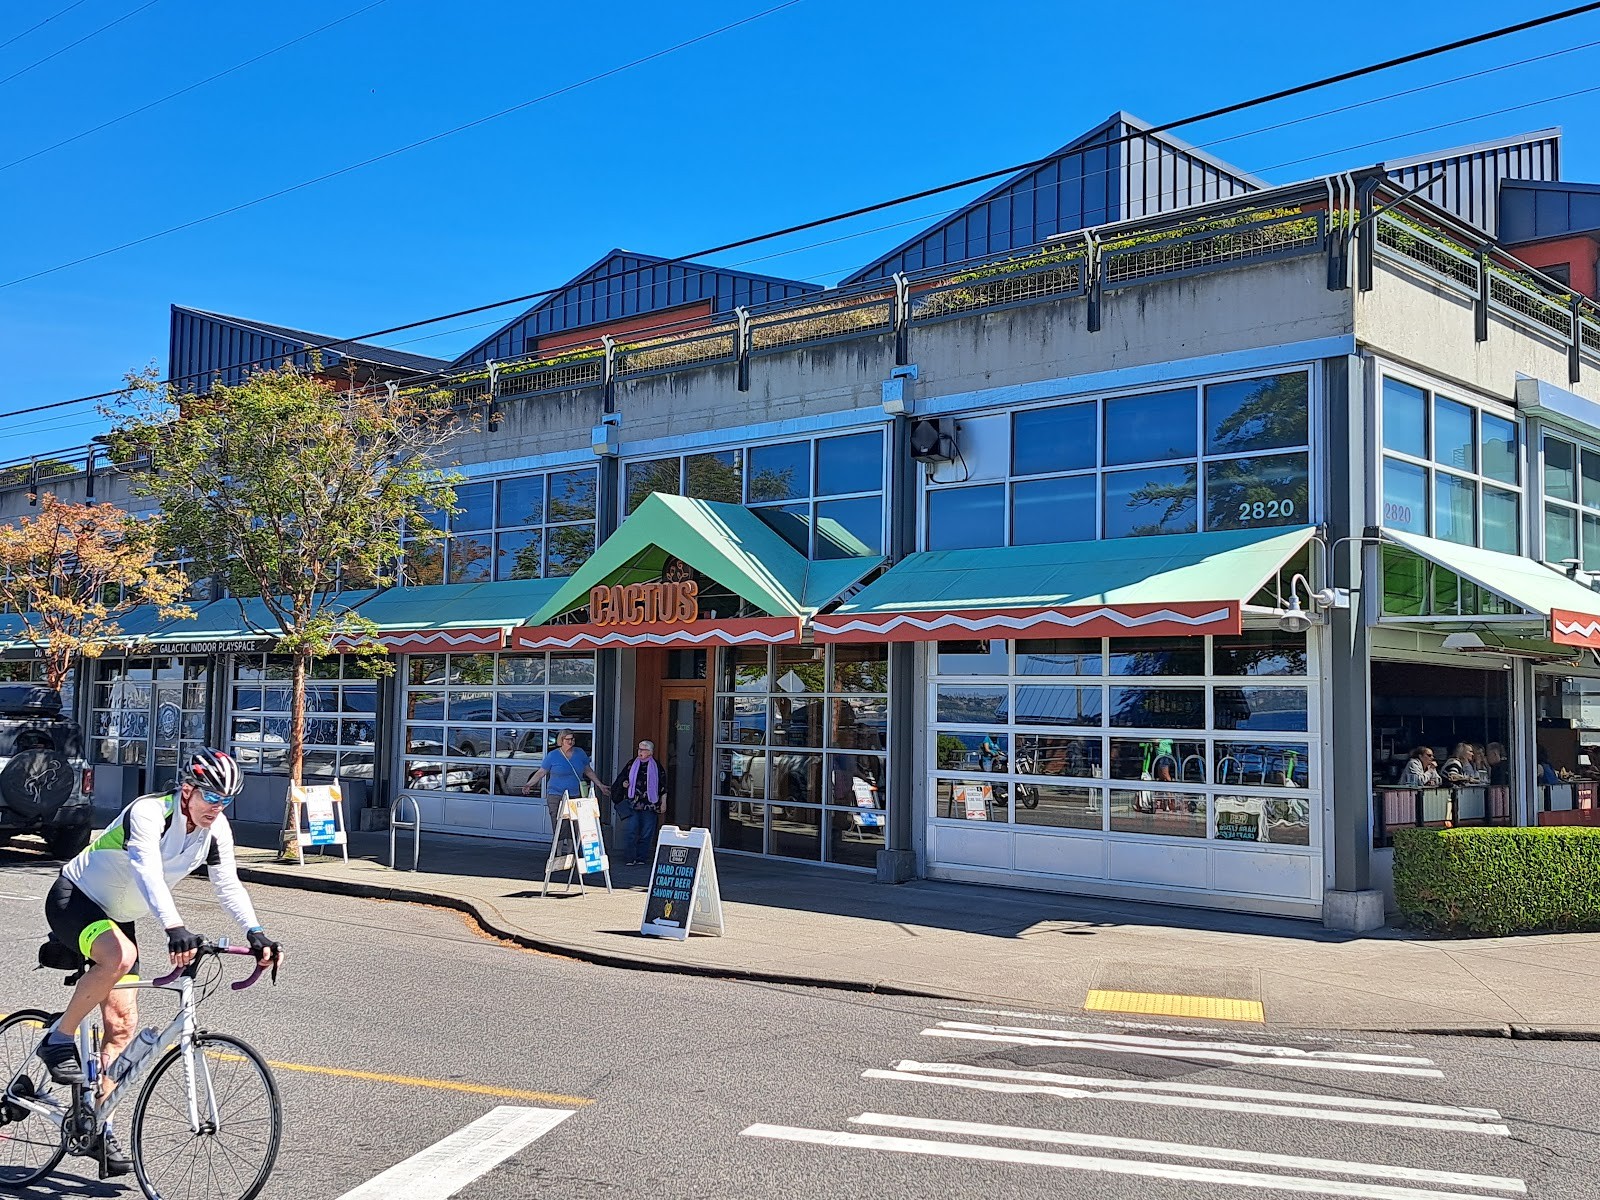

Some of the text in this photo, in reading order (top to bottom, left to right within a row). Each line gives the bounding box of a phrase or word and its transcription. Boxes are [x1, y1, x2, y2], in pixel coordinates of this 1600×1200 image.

[1238, 499, 1295, 520] 2820
[1385, 502, 1411, 524] 2820
[589, 580, 699, 627] CACTUS
[160, 641, 255, 653] GALACTIC INDOOR PLAYSPACE
[657, 864, 695, 878] HARD CIDER
[656, 876, 692, 889] CRAFT BEER
[652, 887, 690, 900] SAVORY BITES
